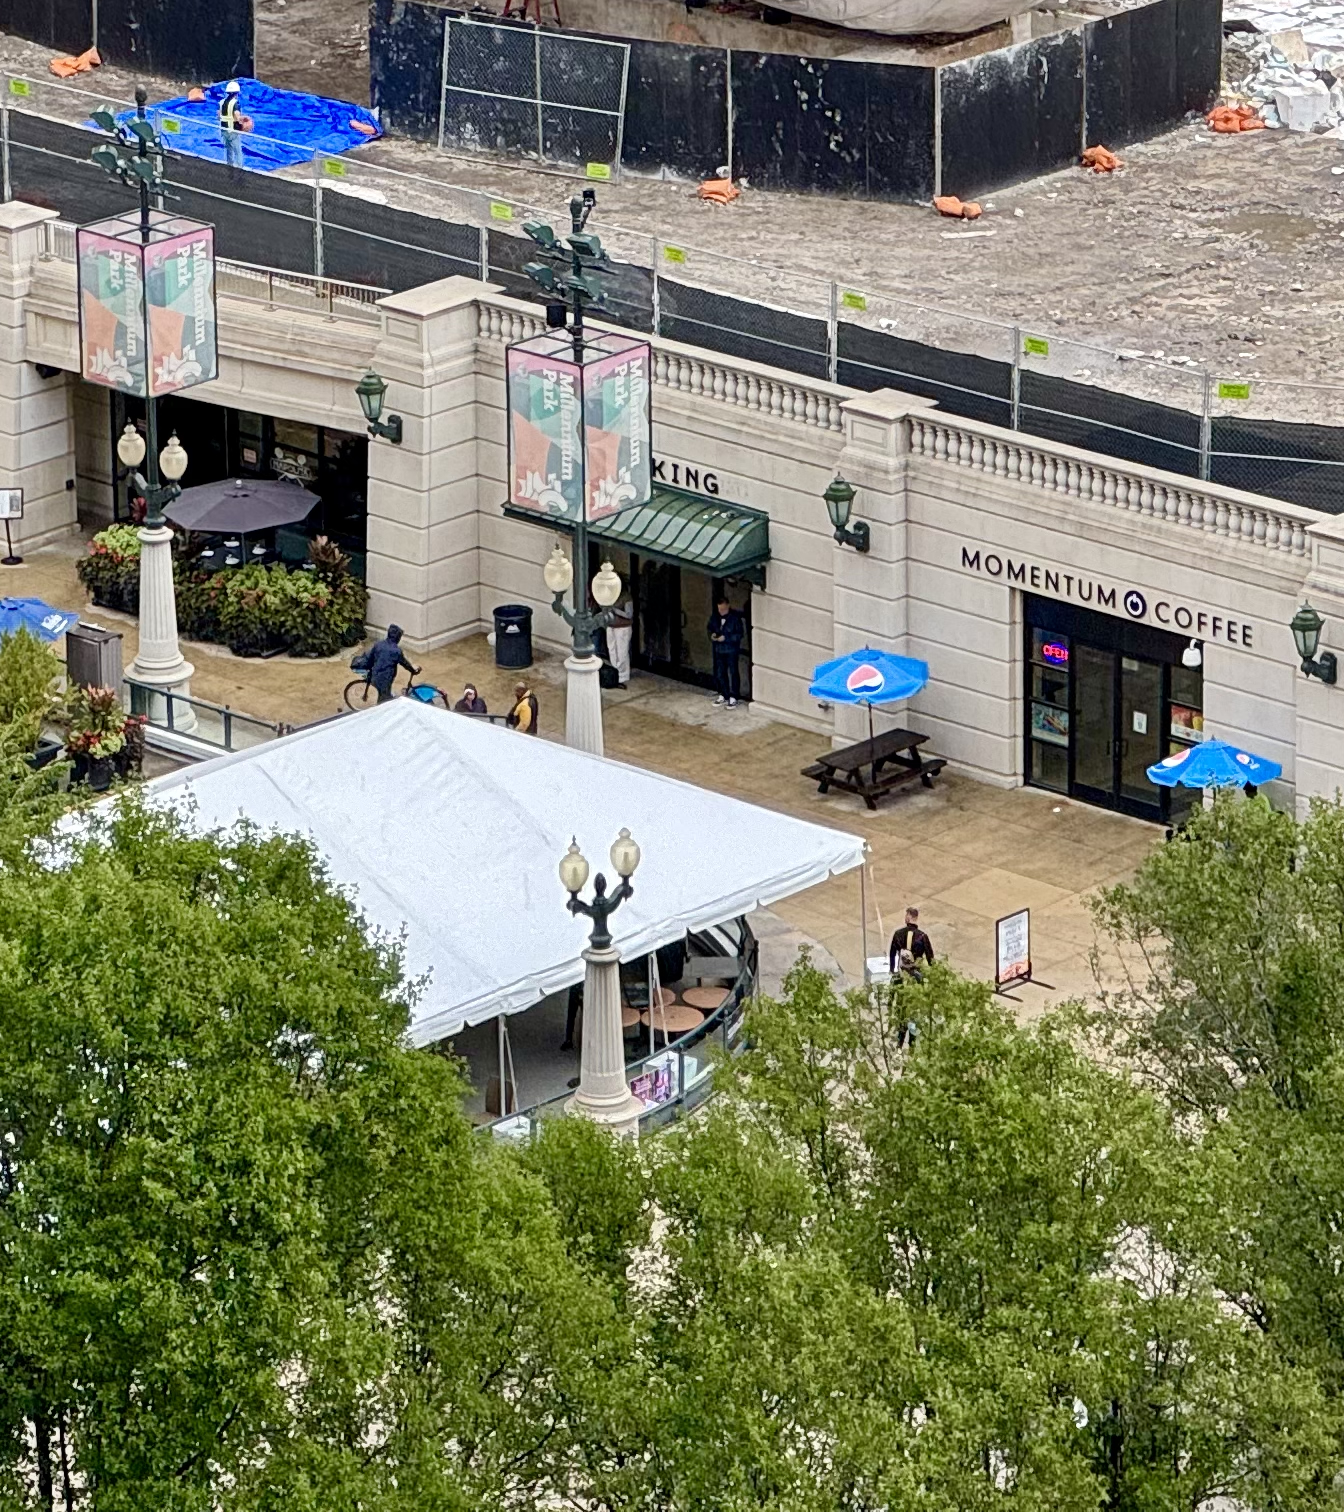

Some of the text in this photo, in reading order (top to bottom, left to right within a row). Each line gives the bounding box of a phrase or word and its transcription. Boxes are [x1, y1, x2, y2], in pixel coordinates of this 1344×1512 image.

[109, 249, 124, 291] Park
[177, 245, 193, 289] Park
[123, 253, 137, 356] Millennium
[192, 240, 206, 346] Millennium
[542, 368, 559, 412] Park
[615, 362, 629, 408] Park
[559, 371, 574, 481] Millennium
[629, 358, 643, 468] Millennium
[652, 458, 719, 495] KING
[962, 547, 1253, 647] MOMENTUM COFFEE
[1043, 645, 1068, 660] OPEN
